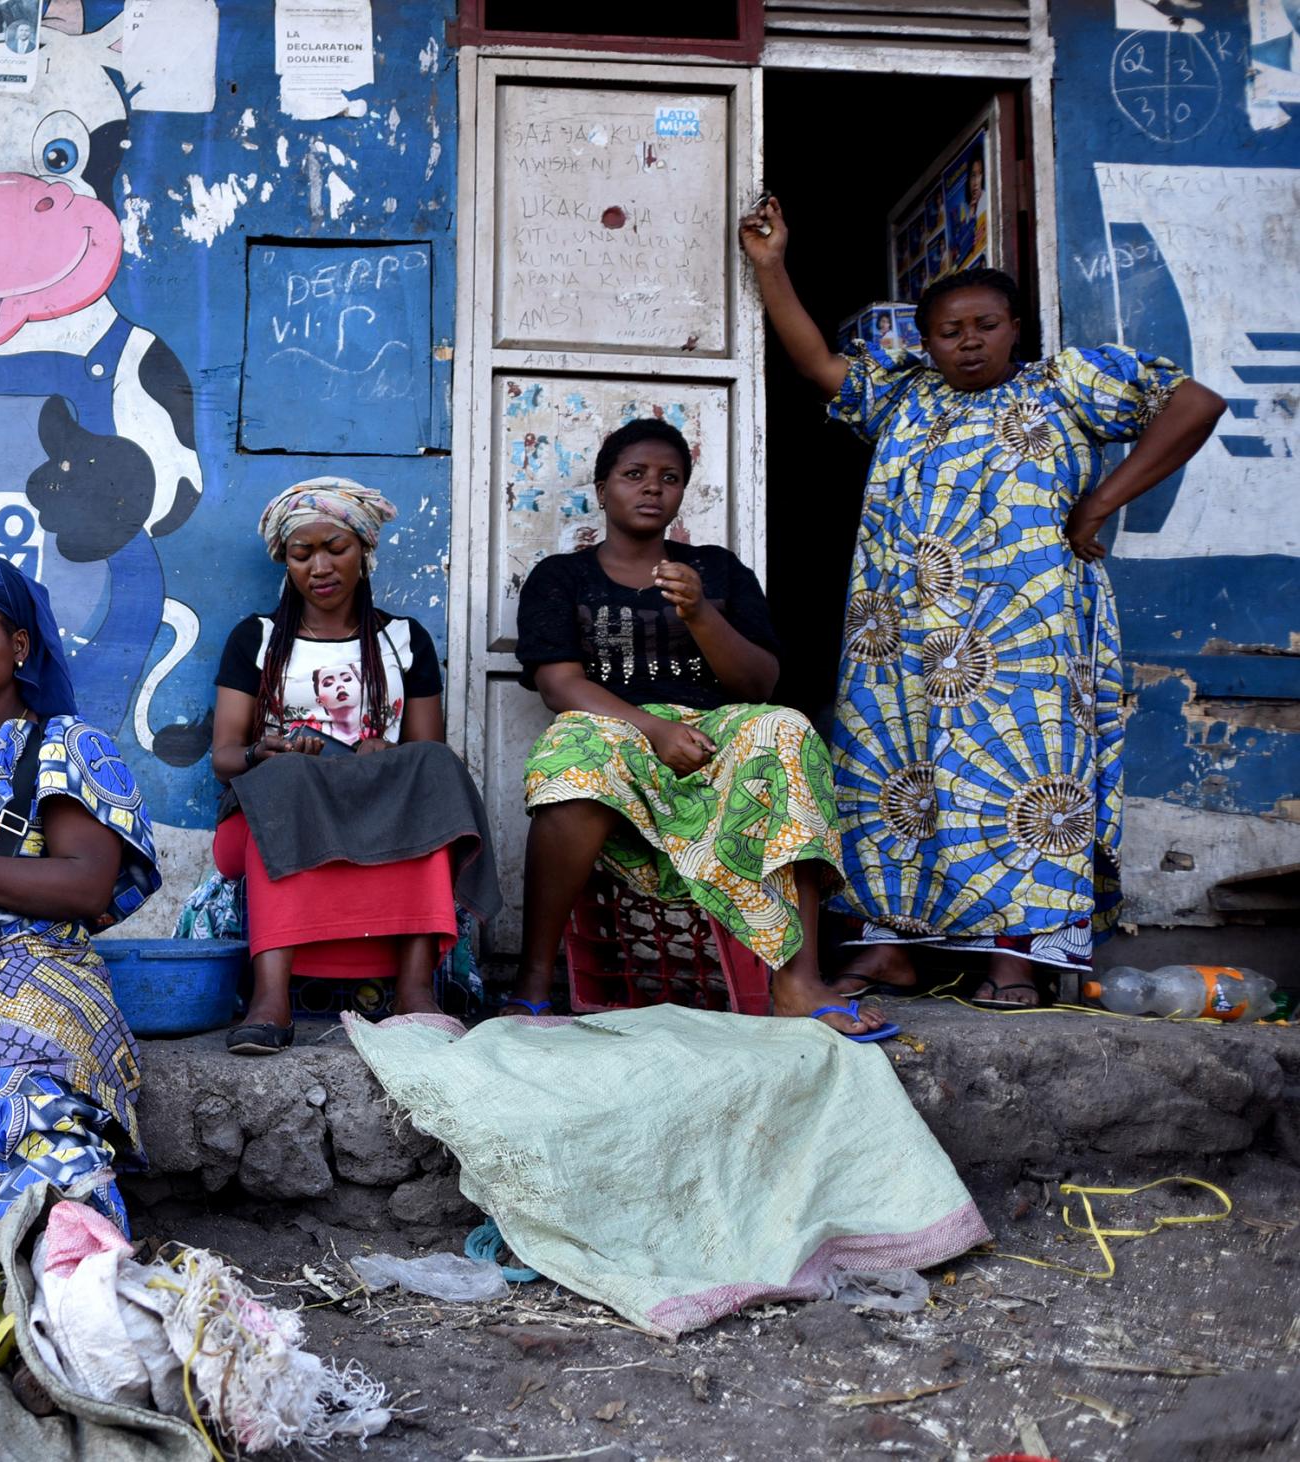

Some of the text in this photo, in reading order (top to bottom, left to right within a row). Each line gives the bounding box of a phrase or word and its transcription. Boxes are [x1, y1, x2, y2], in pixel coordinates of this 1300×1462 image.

[286, 43, 363, 51] DECLARATION
[286, 55, 354, 63] DOUANIERE.
[660, 110, 695, 120] LATO
